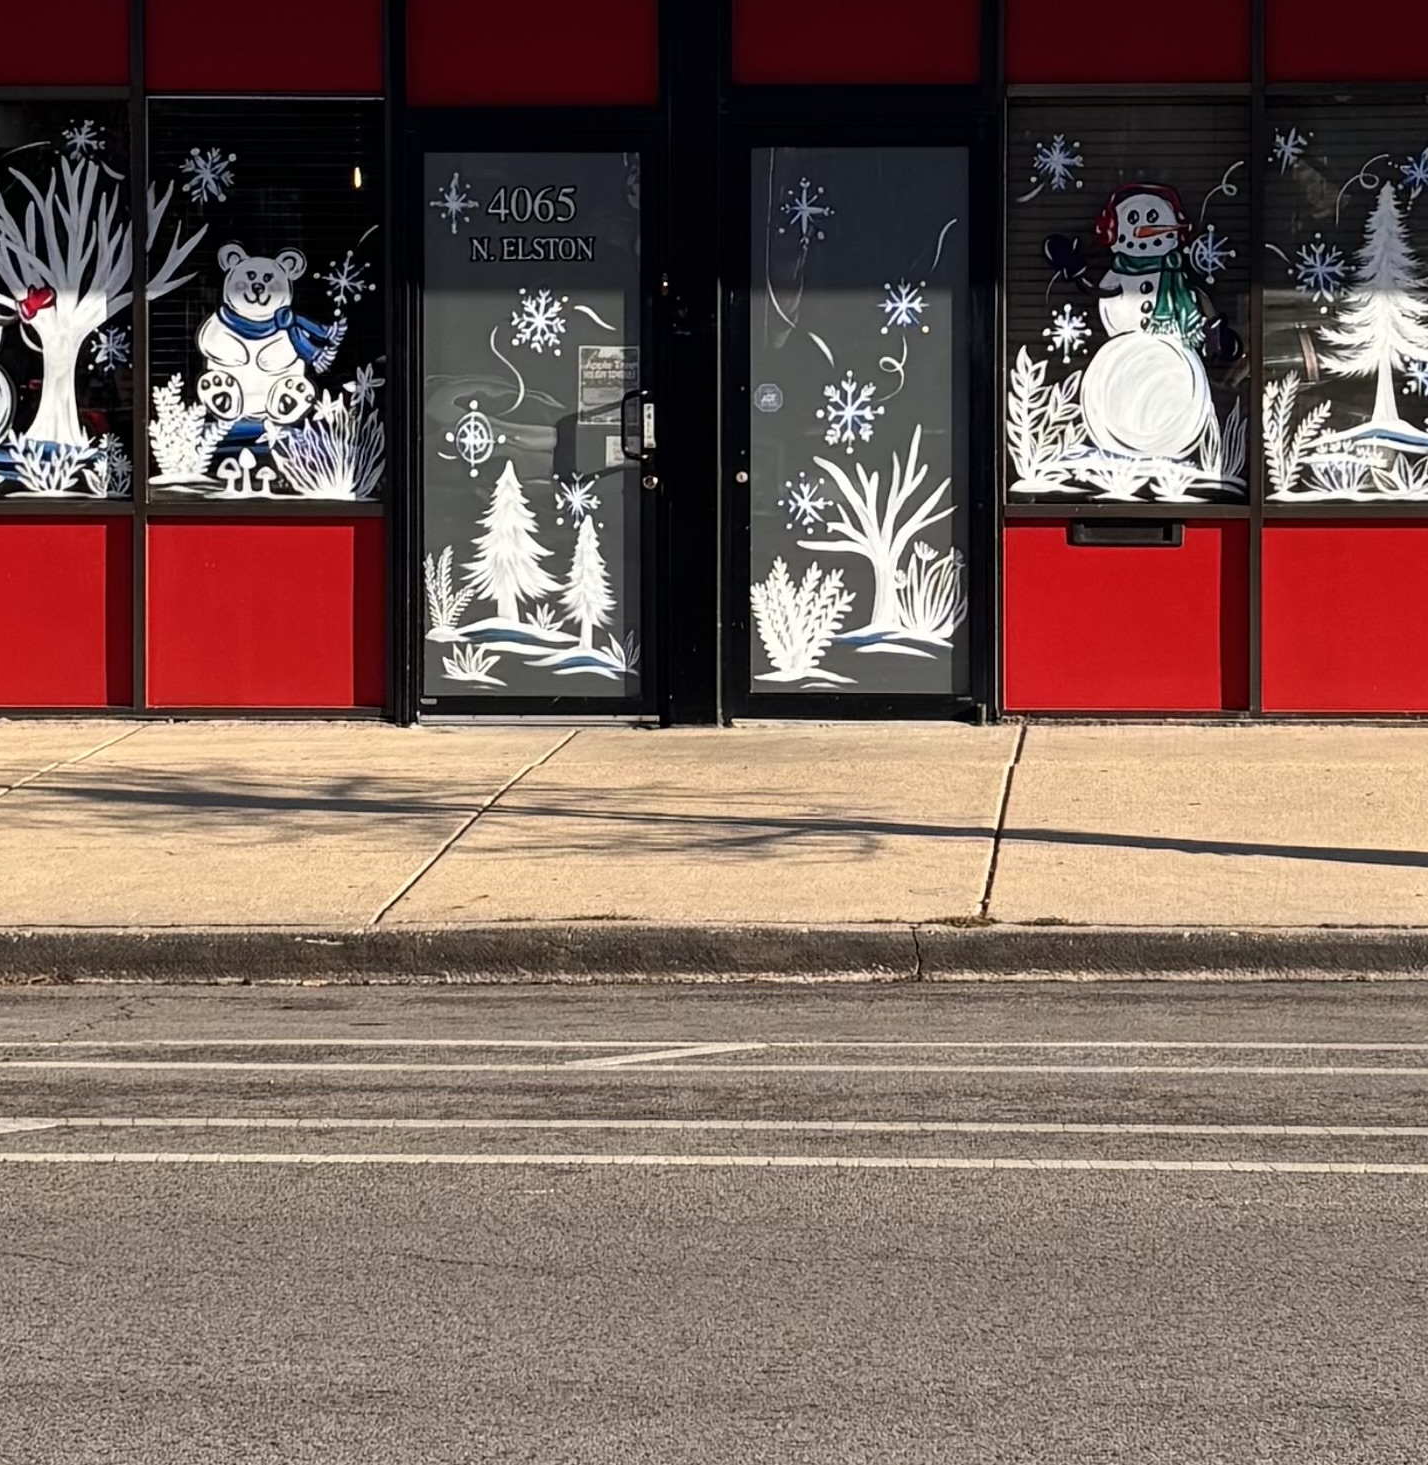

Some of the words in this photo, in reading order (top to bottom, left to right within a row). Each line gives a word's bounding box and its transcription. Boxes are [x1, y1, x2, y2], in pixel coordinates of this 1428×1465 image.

[486, 186, 577, 223] 4065
[471, 237, 496, 261] N.
[501, 237, 594, 261] ELSTON
